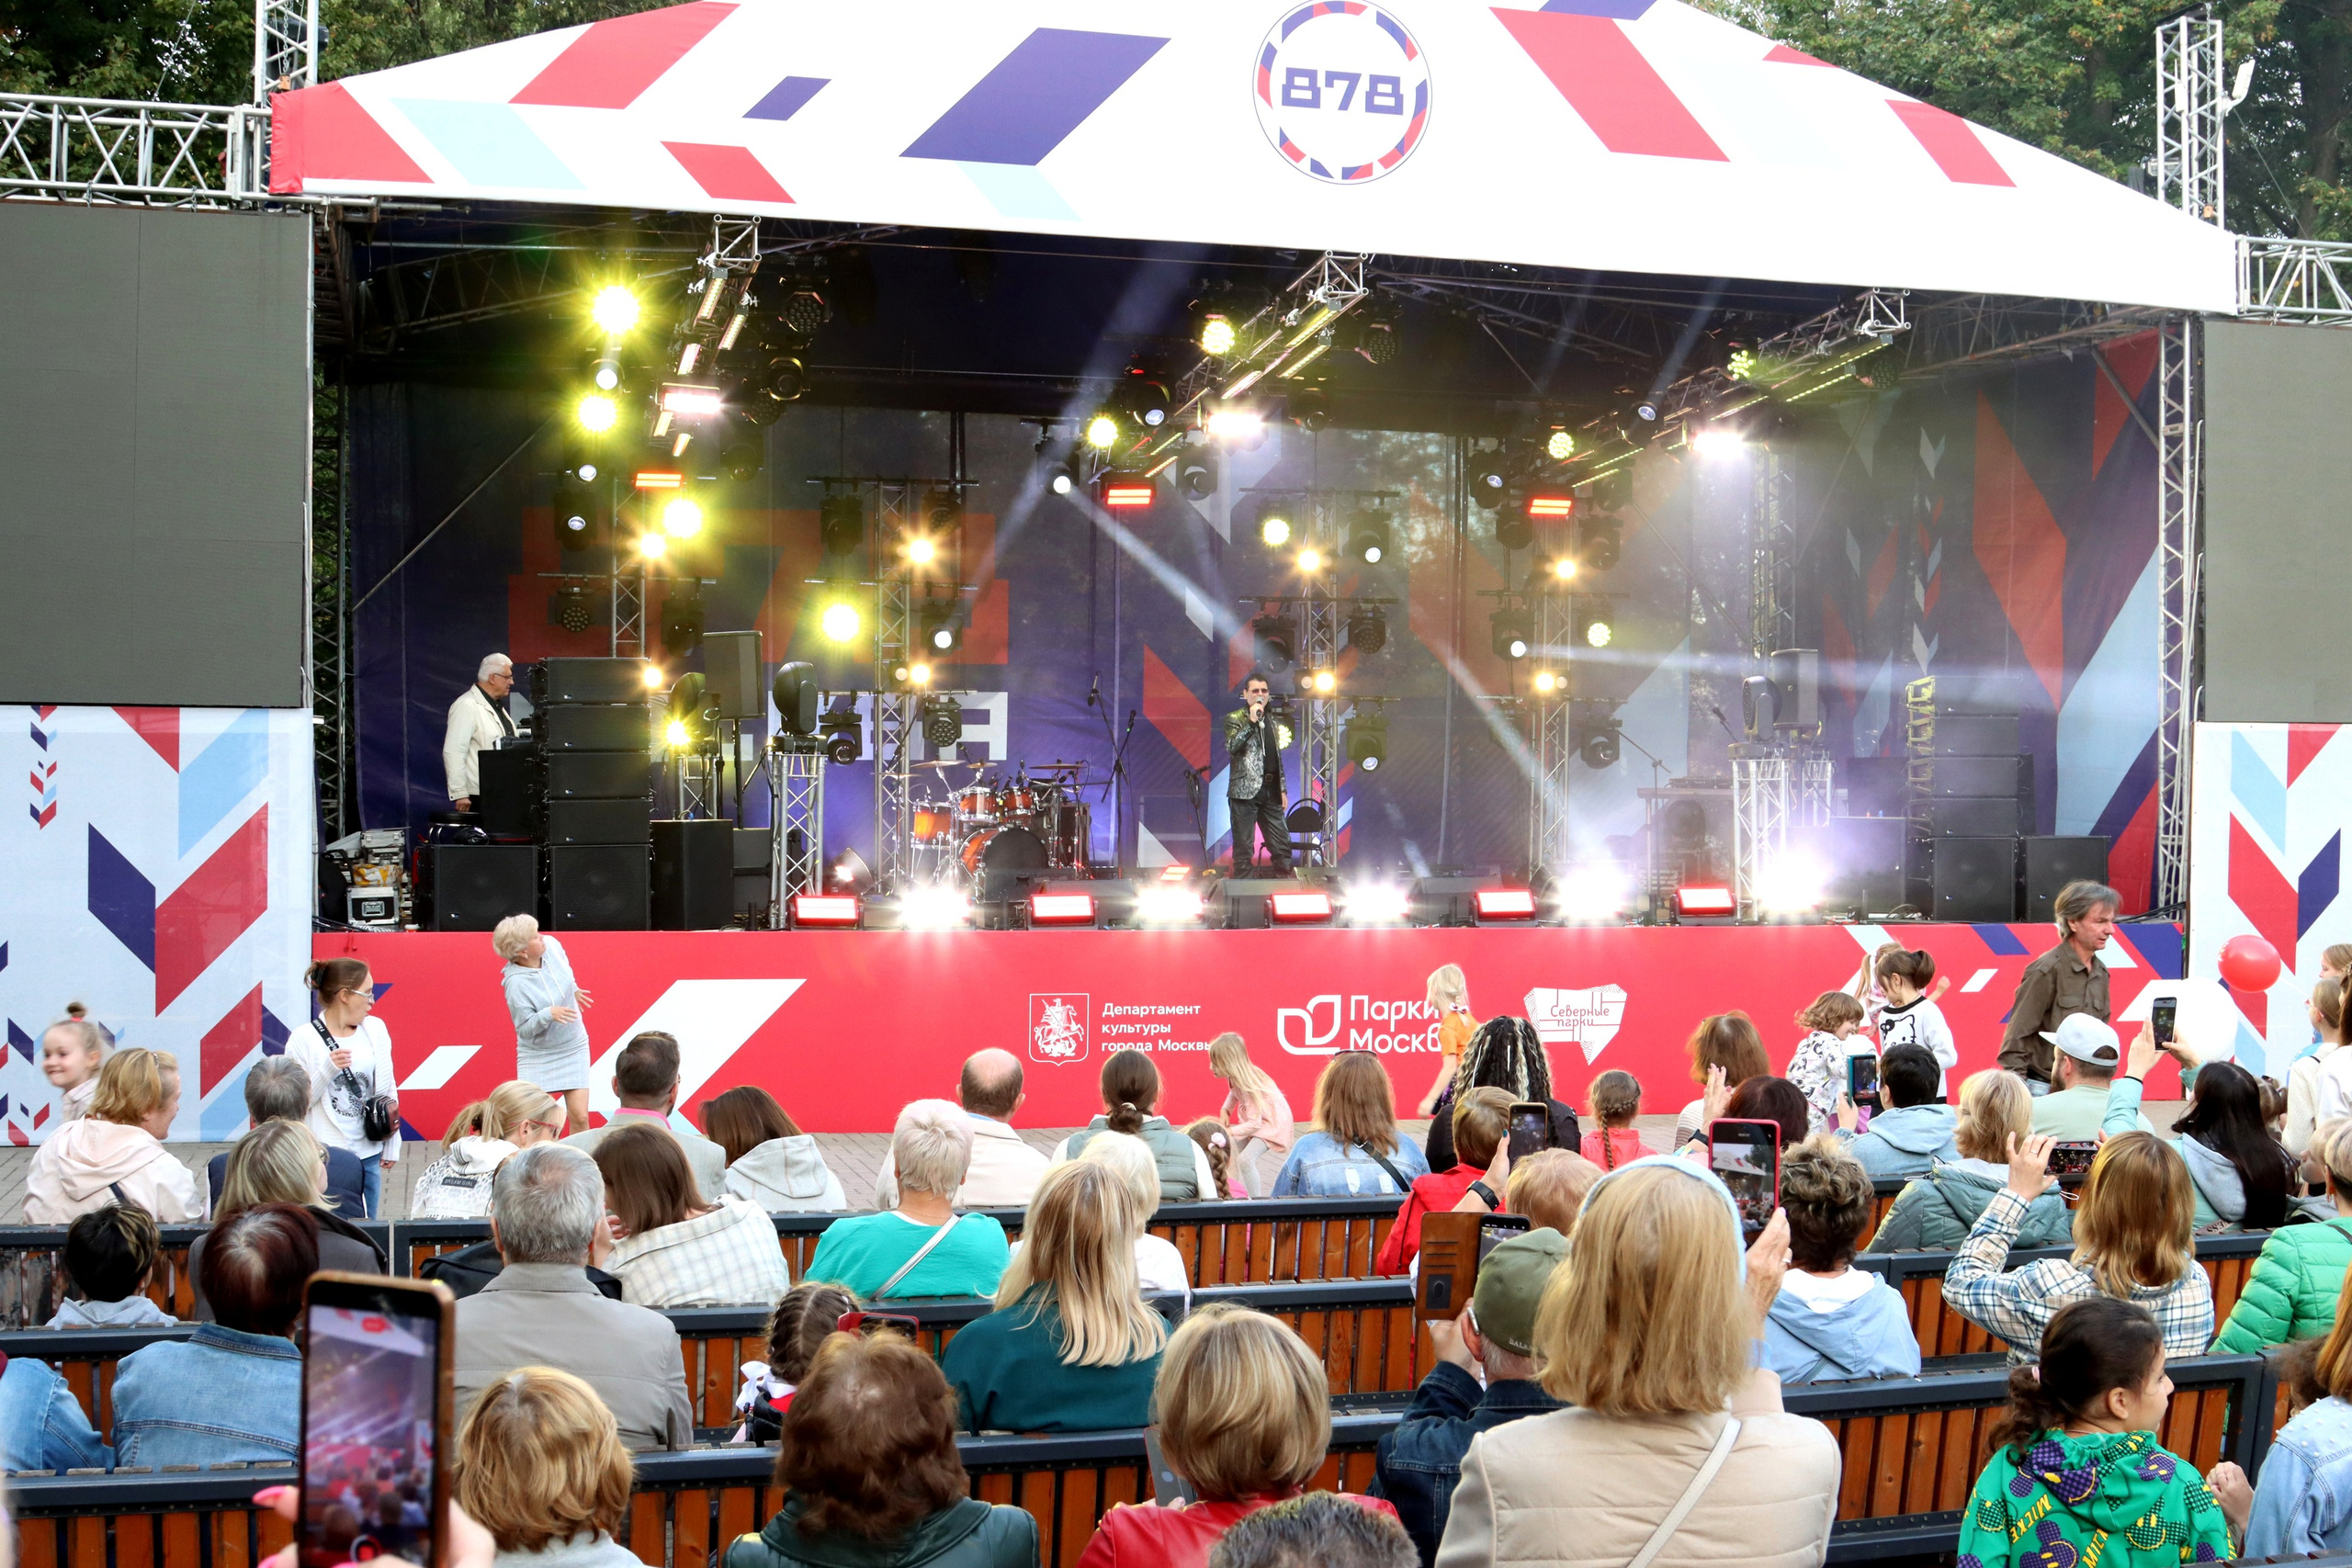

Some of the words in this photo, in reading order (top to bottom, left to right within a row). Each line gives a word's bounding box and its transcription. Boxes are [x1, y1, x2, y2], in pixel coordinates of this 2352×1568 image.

[1282, 67, 1403, 115] 878
[1102, 1003, 1201, 1017] Департамент
[1350, 995, 1439, 1032] Парки
[1551, 1005, 1610, 1018] Северные
[1102, 1023, 1171, 1036] культуры
[1557, 1018, 1594, 1027] парки
[1350, 1022, 1442, 1054] Москв
[1102, 1042, 1153, 1053] города
[2010, 1493, 2053, 1545] MICKE
